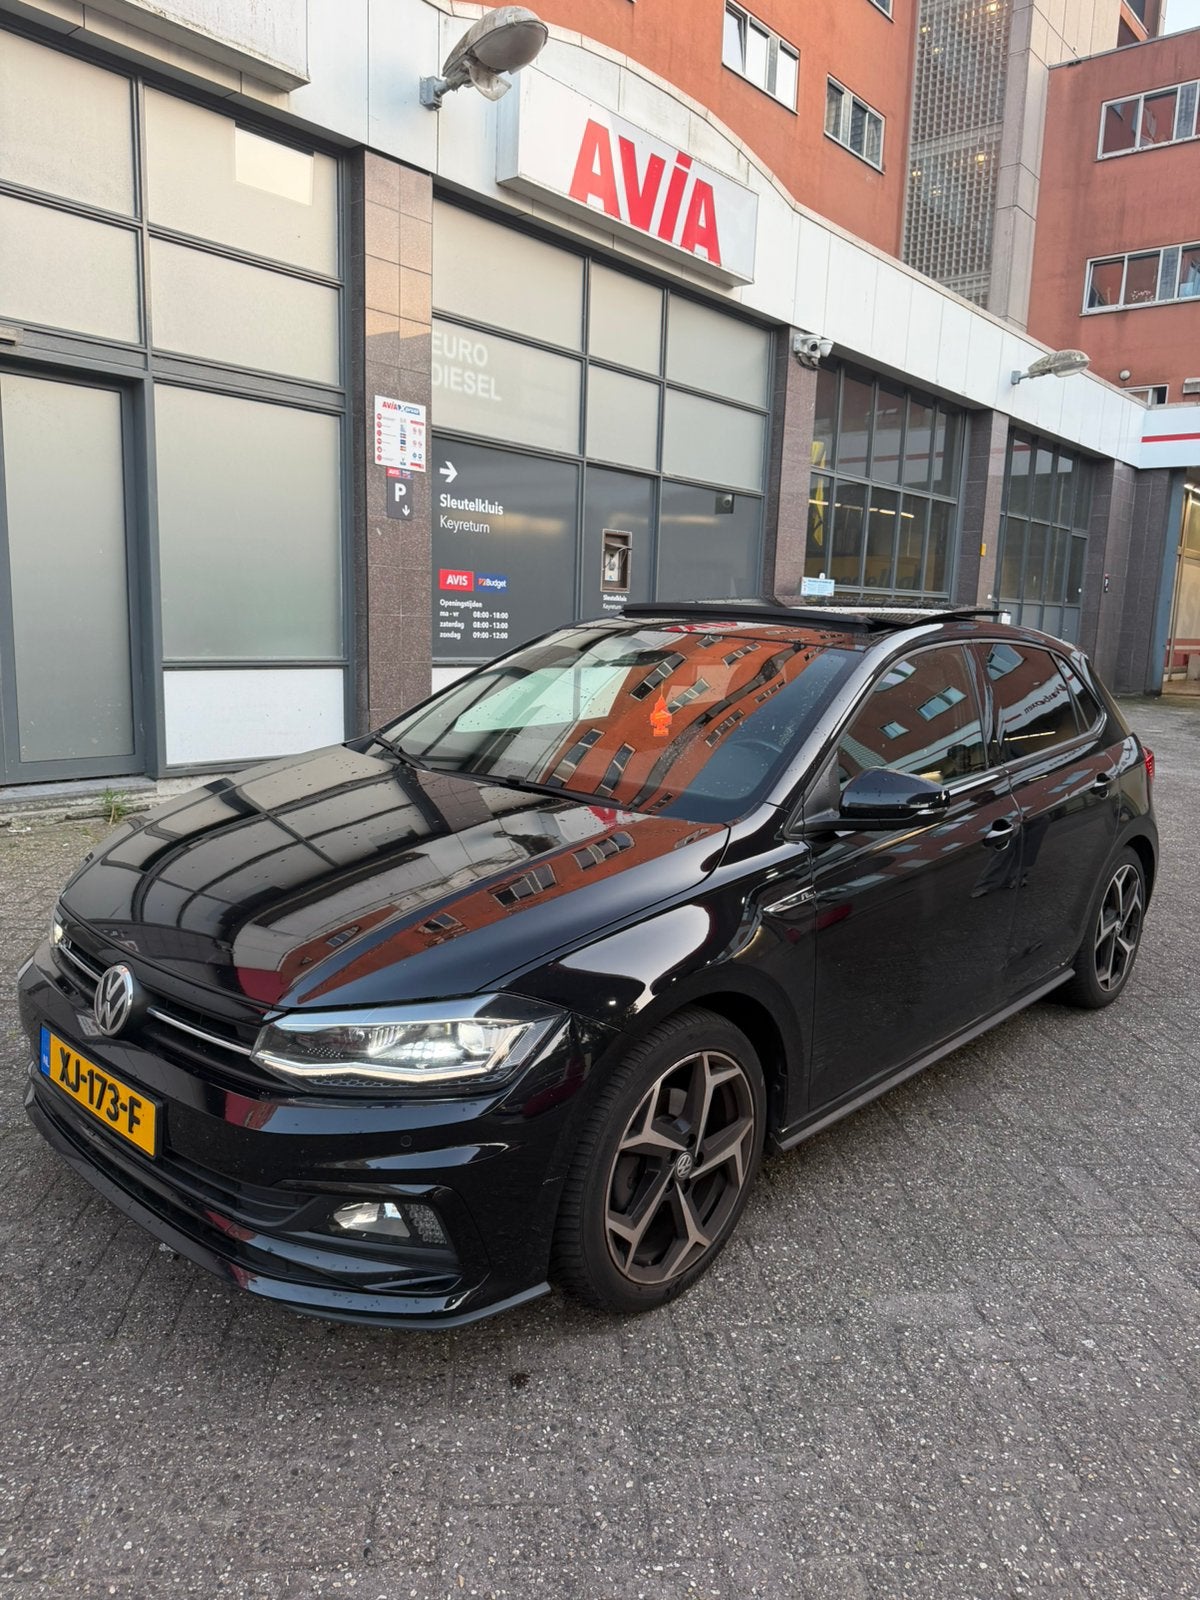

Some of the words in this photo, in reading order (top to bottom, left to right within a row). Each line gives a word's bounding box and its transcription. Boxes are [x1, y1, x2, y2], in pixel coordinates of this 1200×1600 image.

[432, 331, 488, 367] EURO
[394, 482, 407, 502] P
[440, 493, 504, 515] Sleutelkluis
[440, 514, 490, 533] Keyreturn
[446, 574, 468, 586] AVIS
[485, 578, 507, 589] Budget
[439, 598, 483, 609] Openingstijden
[472, 610, 489, 619] 08:00
[439, 621, 465, 630] zaterdag
[472, 621, 489, 629] 08:00
[439, 631, 461, 640] zondag
[472, 631, 489, 639] 09:00
[60, 1046, 142, 1134] XJ-173-F
